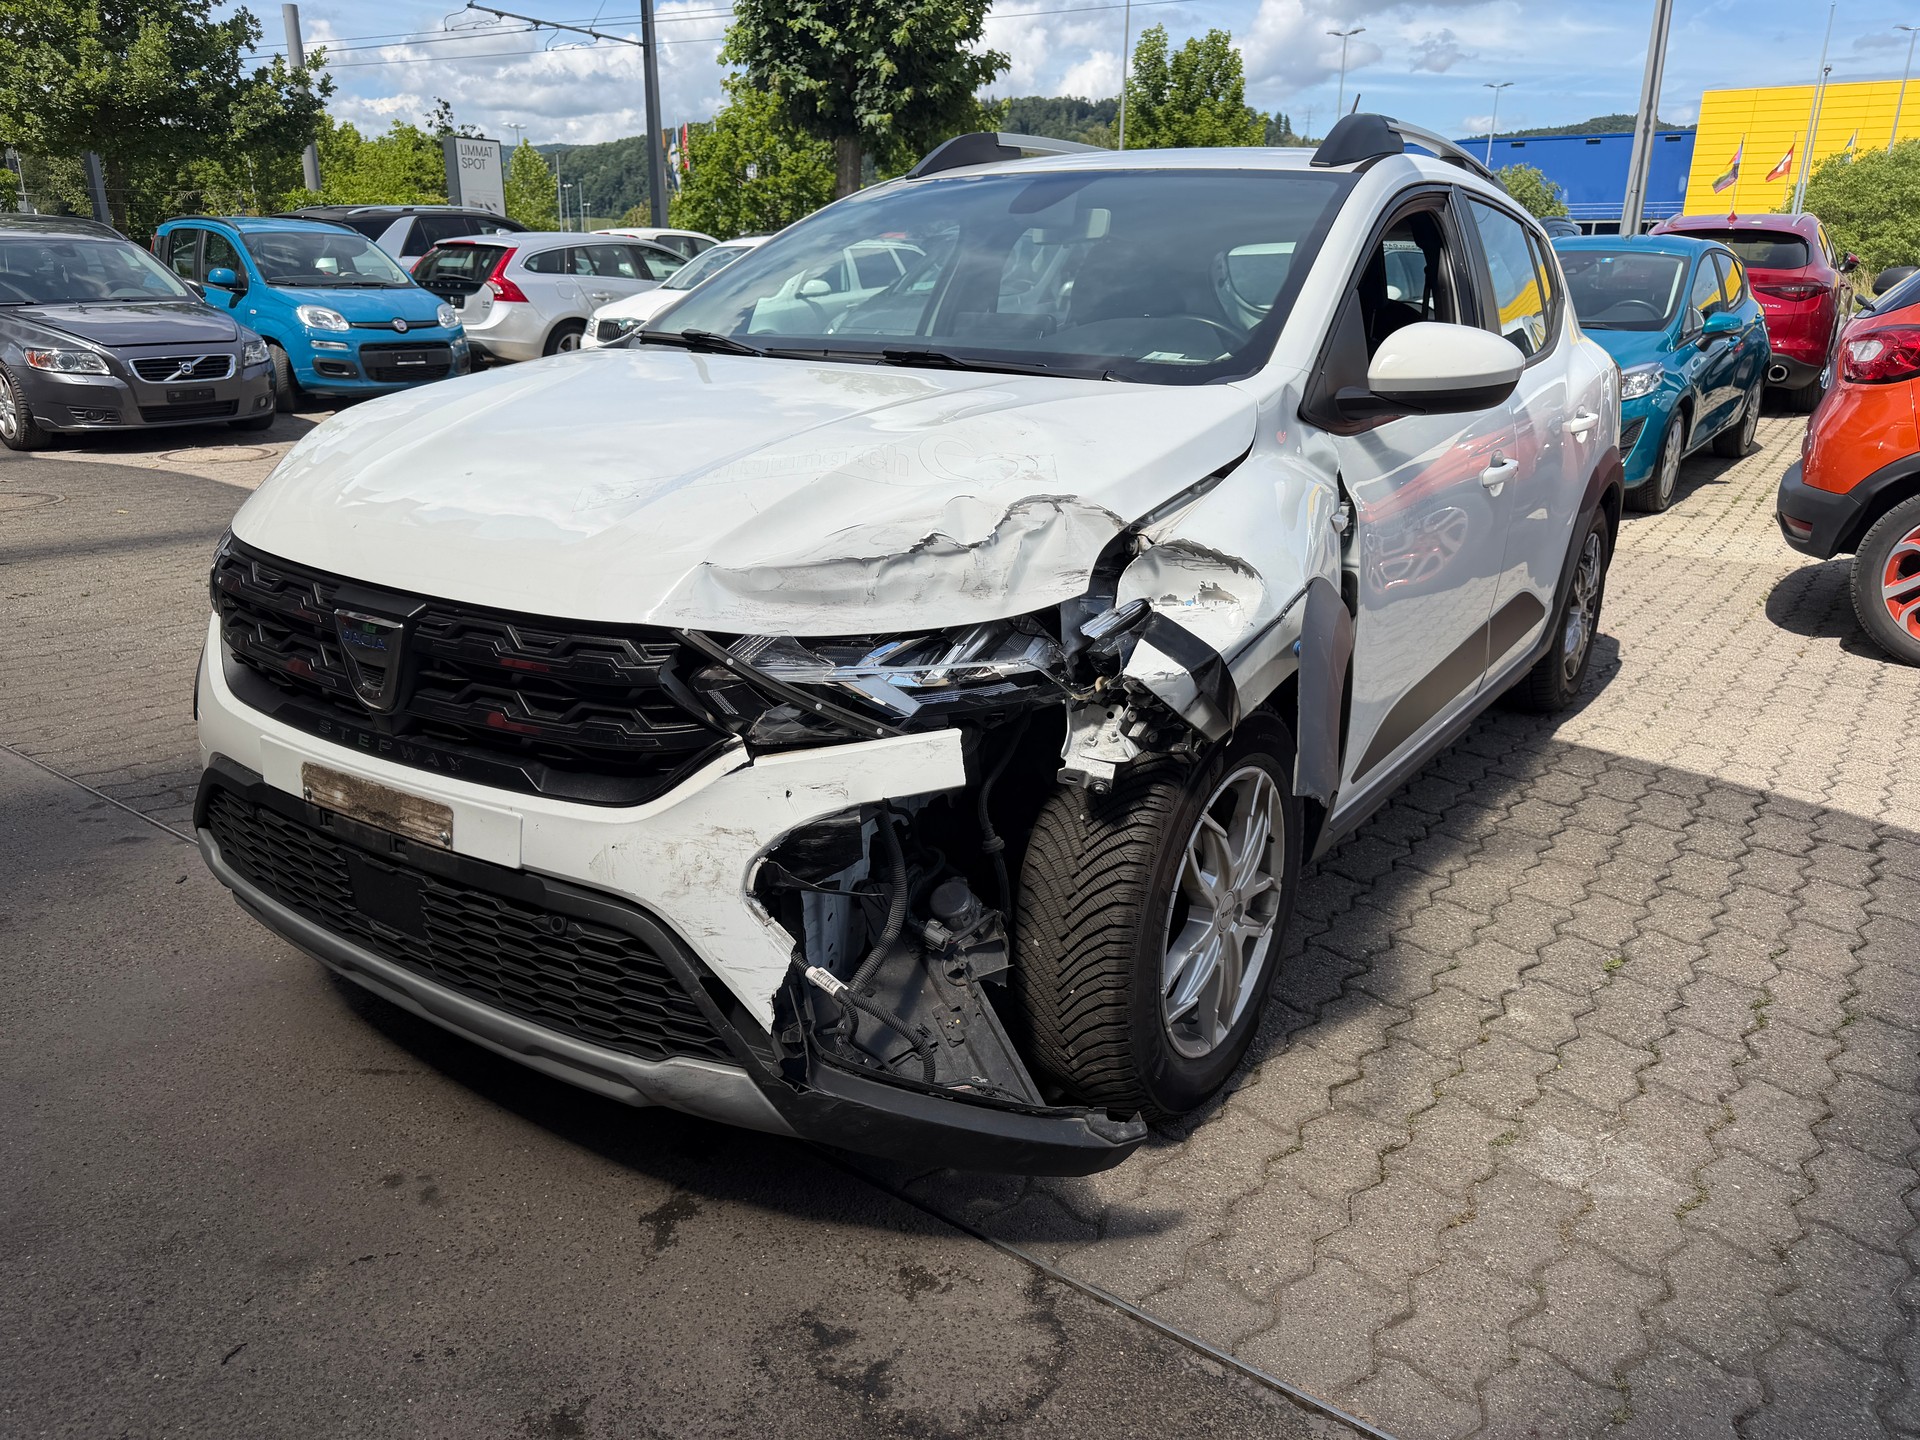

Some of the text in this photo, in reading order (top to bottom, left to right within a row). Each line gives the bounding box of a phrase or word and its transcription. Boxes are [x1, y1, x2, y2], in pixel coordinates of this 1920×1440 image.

[460, 144, 493, 157] LIMMAT
[461, 157, 486, 170] SPOT
[343, 629, 387, 651] DACIA
[318, 719, 463, 771] STEPWAY
